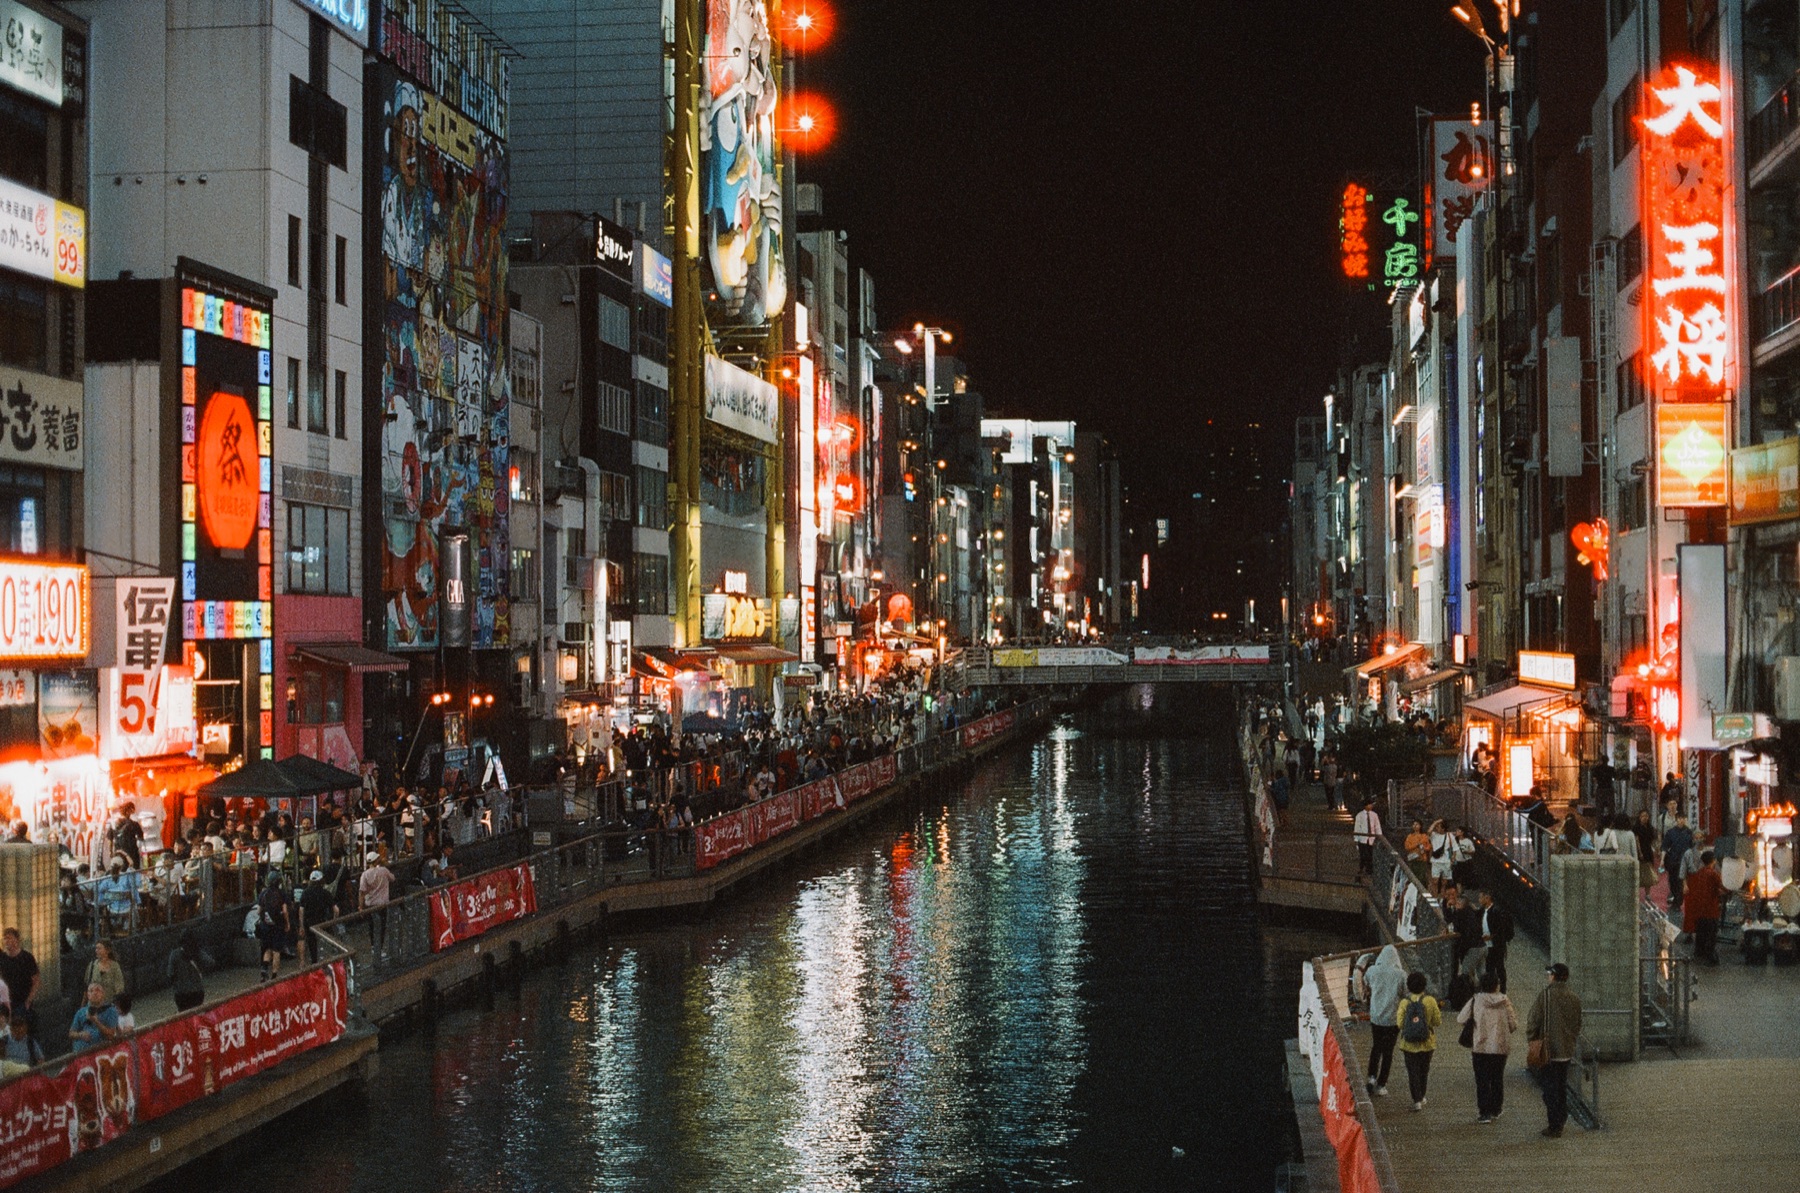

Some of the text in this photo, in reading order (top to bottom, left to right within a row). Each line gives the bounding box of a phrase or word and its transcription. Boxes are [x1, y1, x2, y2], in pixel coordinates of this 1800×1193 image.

[1382, 198, 1419, 276] 千房
[1698, 483, 1724, 500] 2F
[124, 586, 168, 669] 伝串
